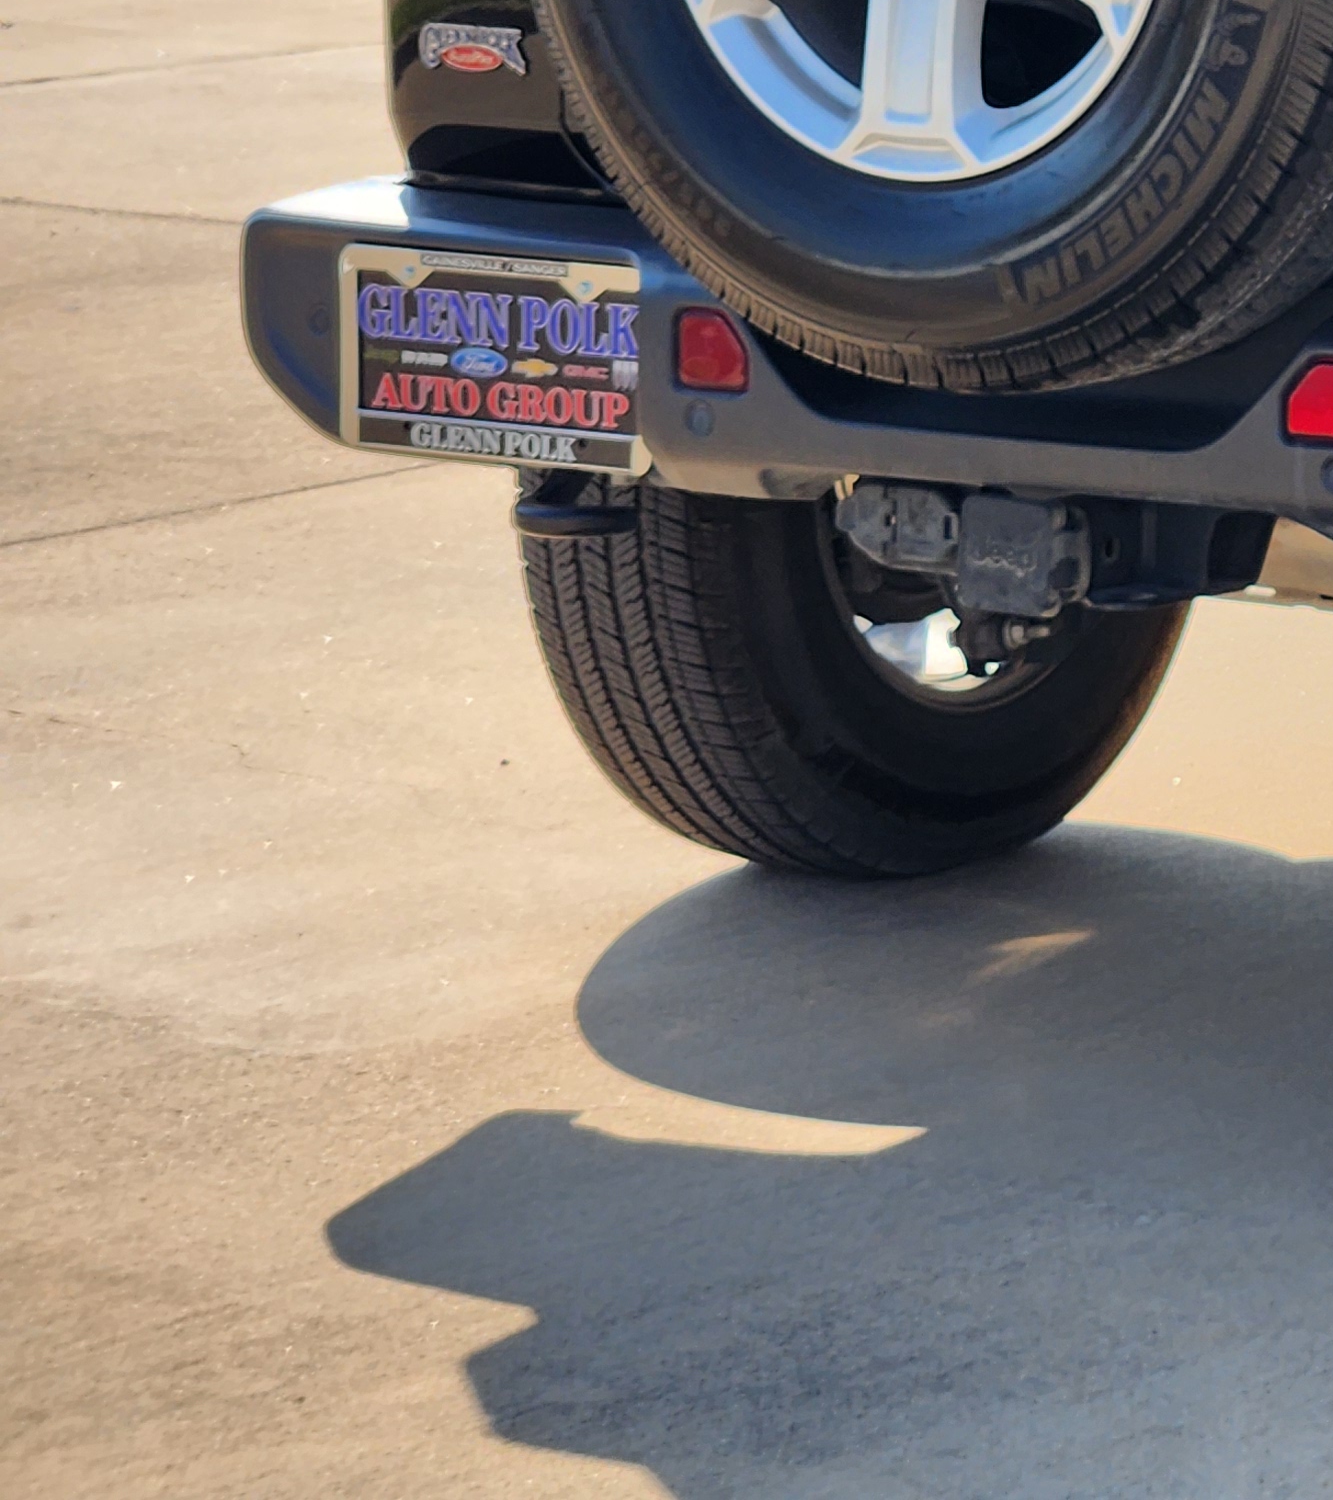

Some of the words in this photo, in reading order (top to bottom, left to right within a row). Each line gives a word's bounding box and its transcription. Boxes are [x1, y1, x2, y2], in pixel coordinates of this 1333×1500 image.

[1022, 78, 1229, 302] MICHELIN
[422, 255, 503, 271] GAINESVILLE
[512, 262, 567, 276] SANGER
[358, 283, 513, 350] GLENN
[517, 296, 640, 359] POLK
[371, 372, 481, 417] AUTO
[486, 381, 630, 429] GROUP
[410, 422, 501, 455] GLENN
[504, 431, 578, 463] POLK
